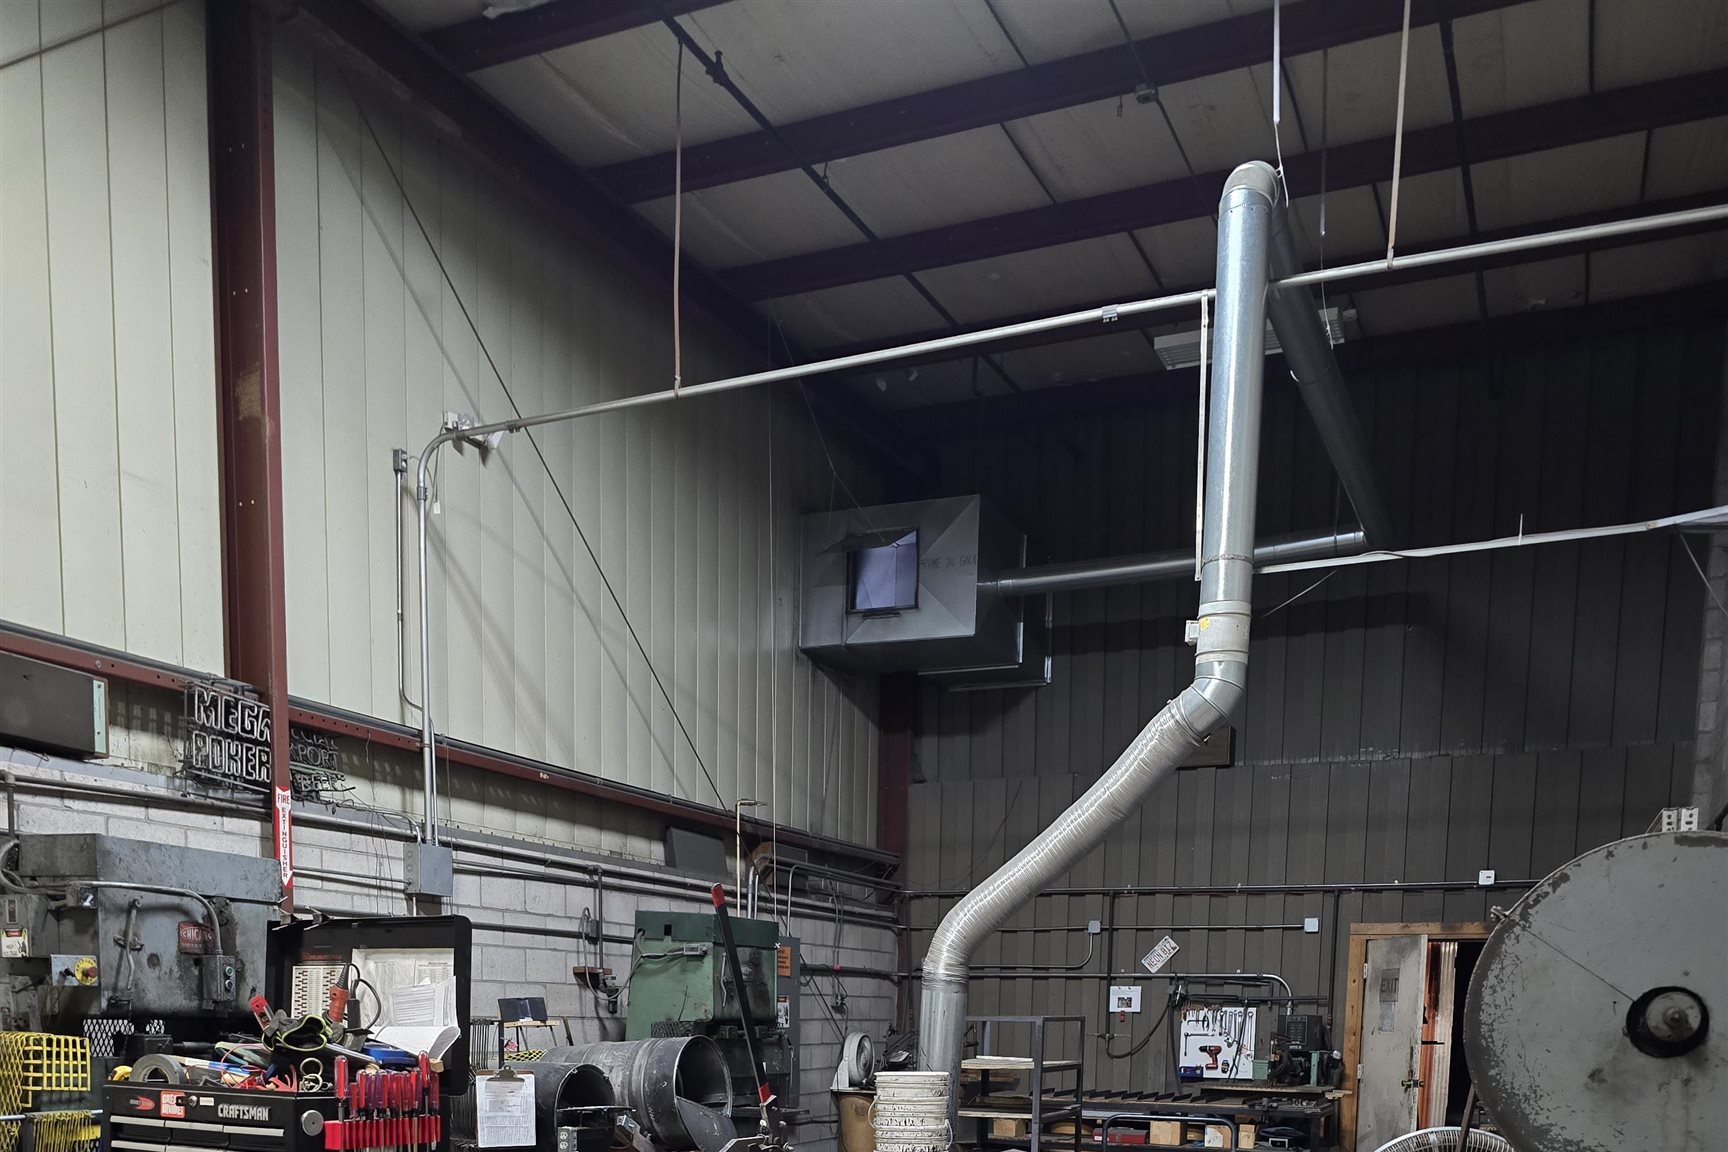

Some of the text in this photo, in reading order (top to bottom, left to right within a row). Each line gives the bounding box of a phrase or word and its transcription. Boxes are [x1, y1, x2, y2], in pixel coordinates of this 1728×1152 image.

[193, 730, 271, 783] POKER
[277, 793, 290, 805] FIRE
[281, 807, 289, 879] EXTINGUISHER
[1146, 950, 1164, 969] NEON
[1161, 940, 1176, 956] BIZ
[1381, 977, 1399, 993] EXIT
[217, 1103, 270, 1122] CRAFTSMAN
